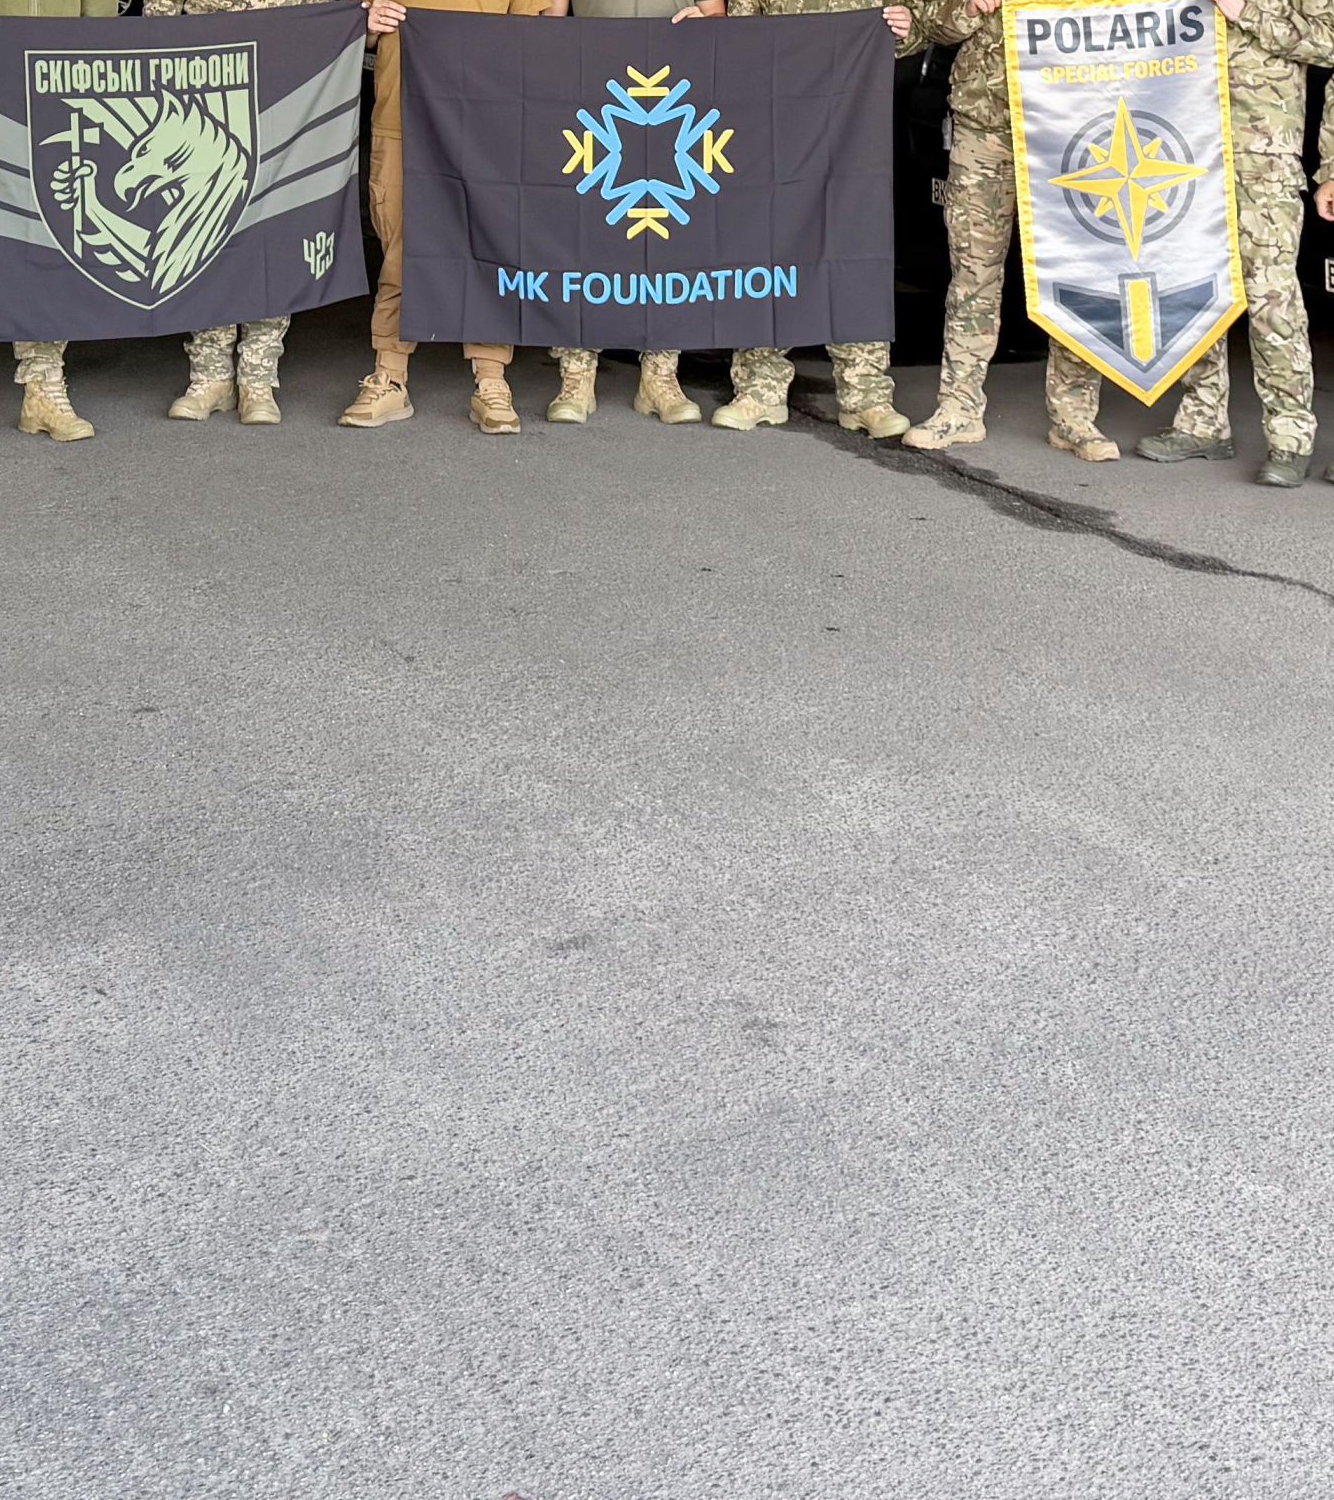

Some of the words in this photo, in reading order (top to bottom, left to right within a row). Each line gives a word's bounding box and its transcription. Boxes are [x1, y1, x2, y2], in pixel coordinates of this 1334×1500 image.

[1026, 4, 1206, 56] POLARIS
[34, 59, 142, 94] СКІФСЬКІ
[148, 51, 250, 92] ГРИФОНИ
[1040, 63, 1121, 85] SPECIAL
[1123, 54, 1200, 80] FORCES
[497, 266, 549, 302] MK
[562, 264, 797, 305] FOUNDATION
